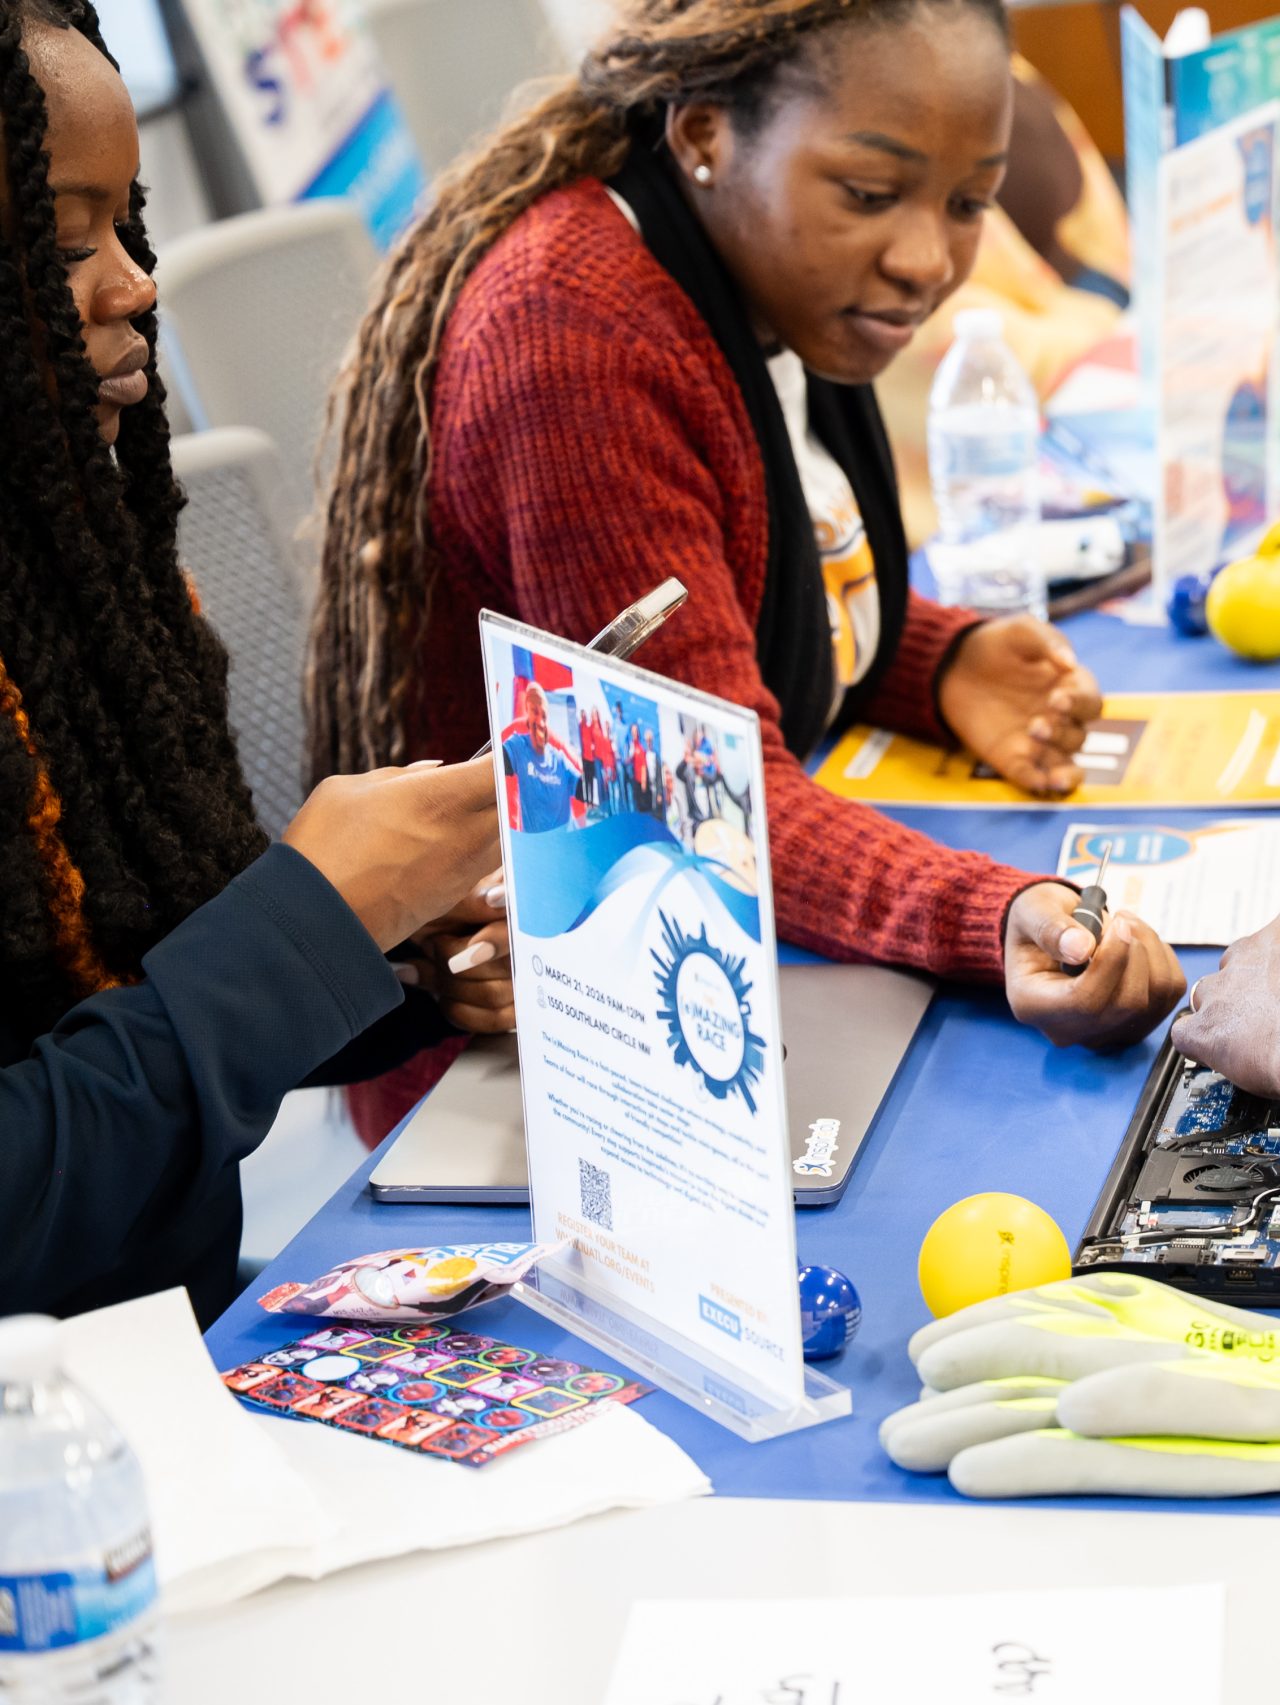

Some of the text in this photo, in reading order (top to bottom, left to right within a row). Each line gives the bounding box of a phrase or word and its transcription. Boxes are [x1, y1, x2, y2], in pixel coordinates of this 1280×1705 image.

[545, 966, 571, 984] MARCH
[573, 979, 584, 994] 21,
[586, 985, 605, 1003] 2026
[547, 995, 563, 1012] 1550
[565, 1005, 609, 1034] SOUTHLAND
[611, 1027, 635, 1048] CIRCLE
[696, 1023, 725, 1052] RACE
[557, 1211, 650, 1272] REGISTER YOUR TEAM AT
[703, 1302, 737, 1333] EXECU
